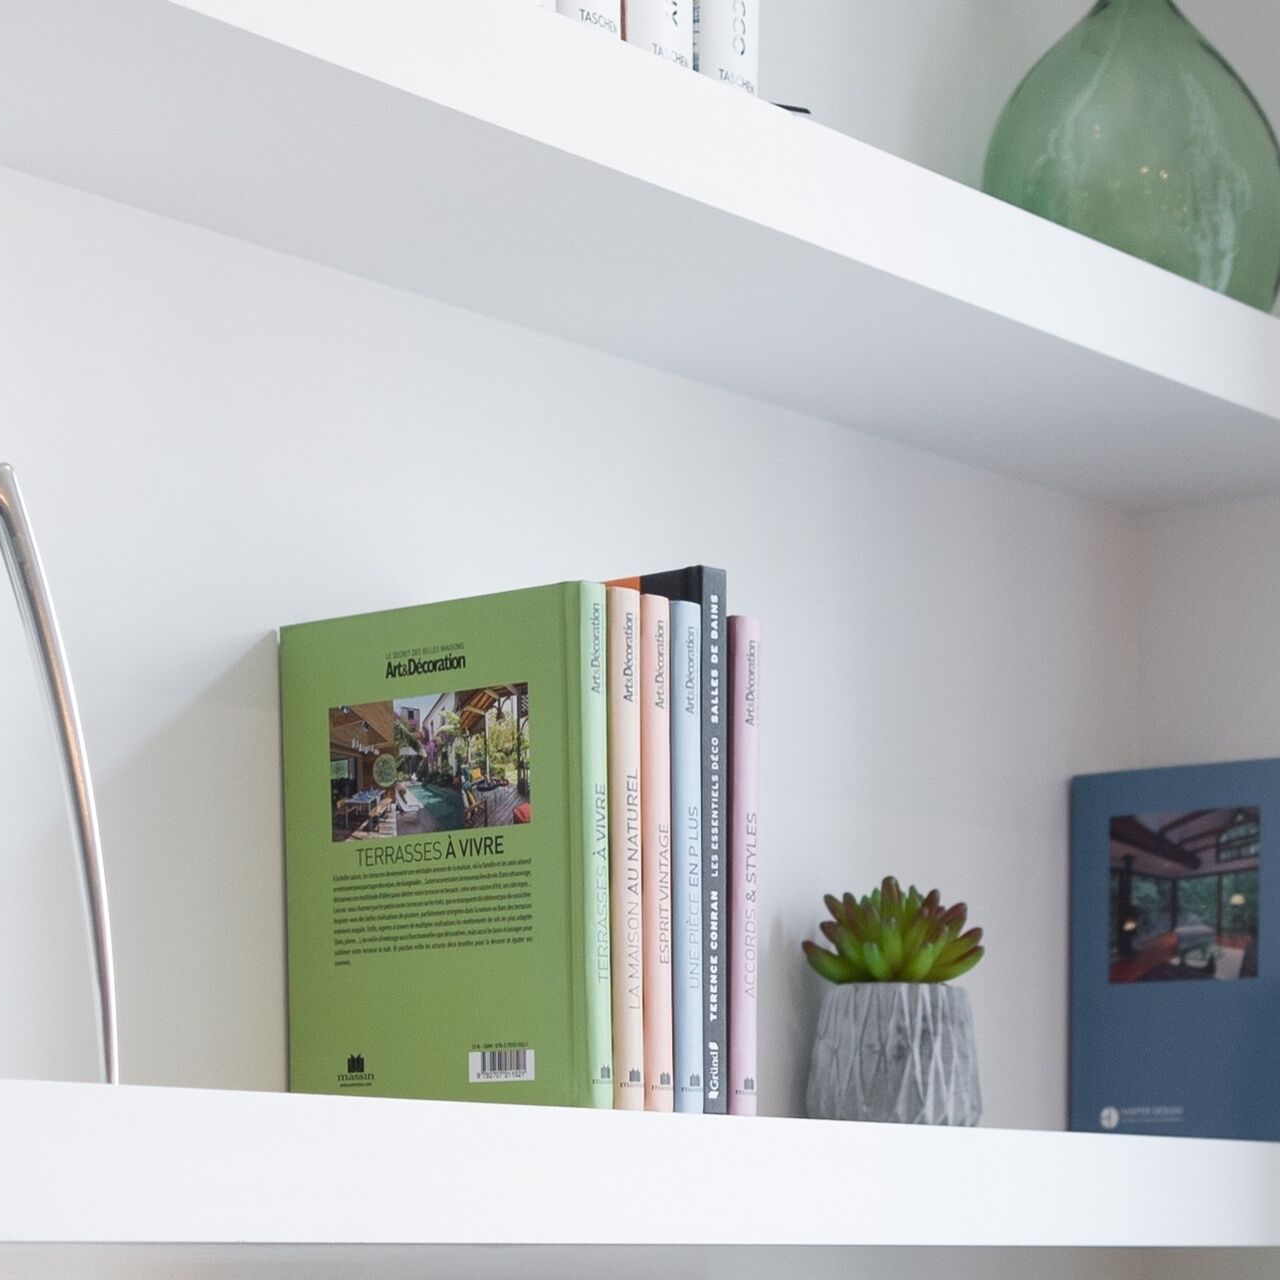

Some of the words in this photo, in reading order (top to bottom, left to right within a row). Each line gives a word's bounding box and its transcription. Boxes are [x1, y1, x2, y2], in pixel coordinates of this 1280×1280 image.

[579, 9, 617, 34] TASCHEN
[709, 594, 719, 640] BAINS
[710, 644, 719, 664] DE
[710, 669, 719, 724] SALLES
[708, 737, 719, 771] DÉCO
[595, 783, 607, 841] VIVRE
[626, 768, 639, 862] NATUREL
[710, 774, 719, 850] ESSENTIELS
[355, 842, 441, 867] TERRASSES
[445, 834, 456, 860] À
[459, 835, 504, 858] VIVRE
[592, 846, 607, 860] À
[658, 824, 670, 902] VINTAGE
[710, 854, 719, 877] LES
[745, 811, 758, 882] STYLES
[627, 867, 640, 896] AU
[688, 861, 700, 888] EN
[745, 890, 757, 903] &
[597, 865, 610, 981] TERRASSES
[627, 901, 641, 980] MAISON
[659, 902, 671, 963] ESPRIT
[685, 890, 700, 942] PIÈCE
[710, 890, 719, 950] CONRAN
[688, 950, 700, 991] UNE
[745, 907, 757, 1000] ACCORDS
[628, 992, 641, 1010] LA
[710, 955, 719, 1022] TERENCE
[707, 1049, 720, 1091] Gründ
